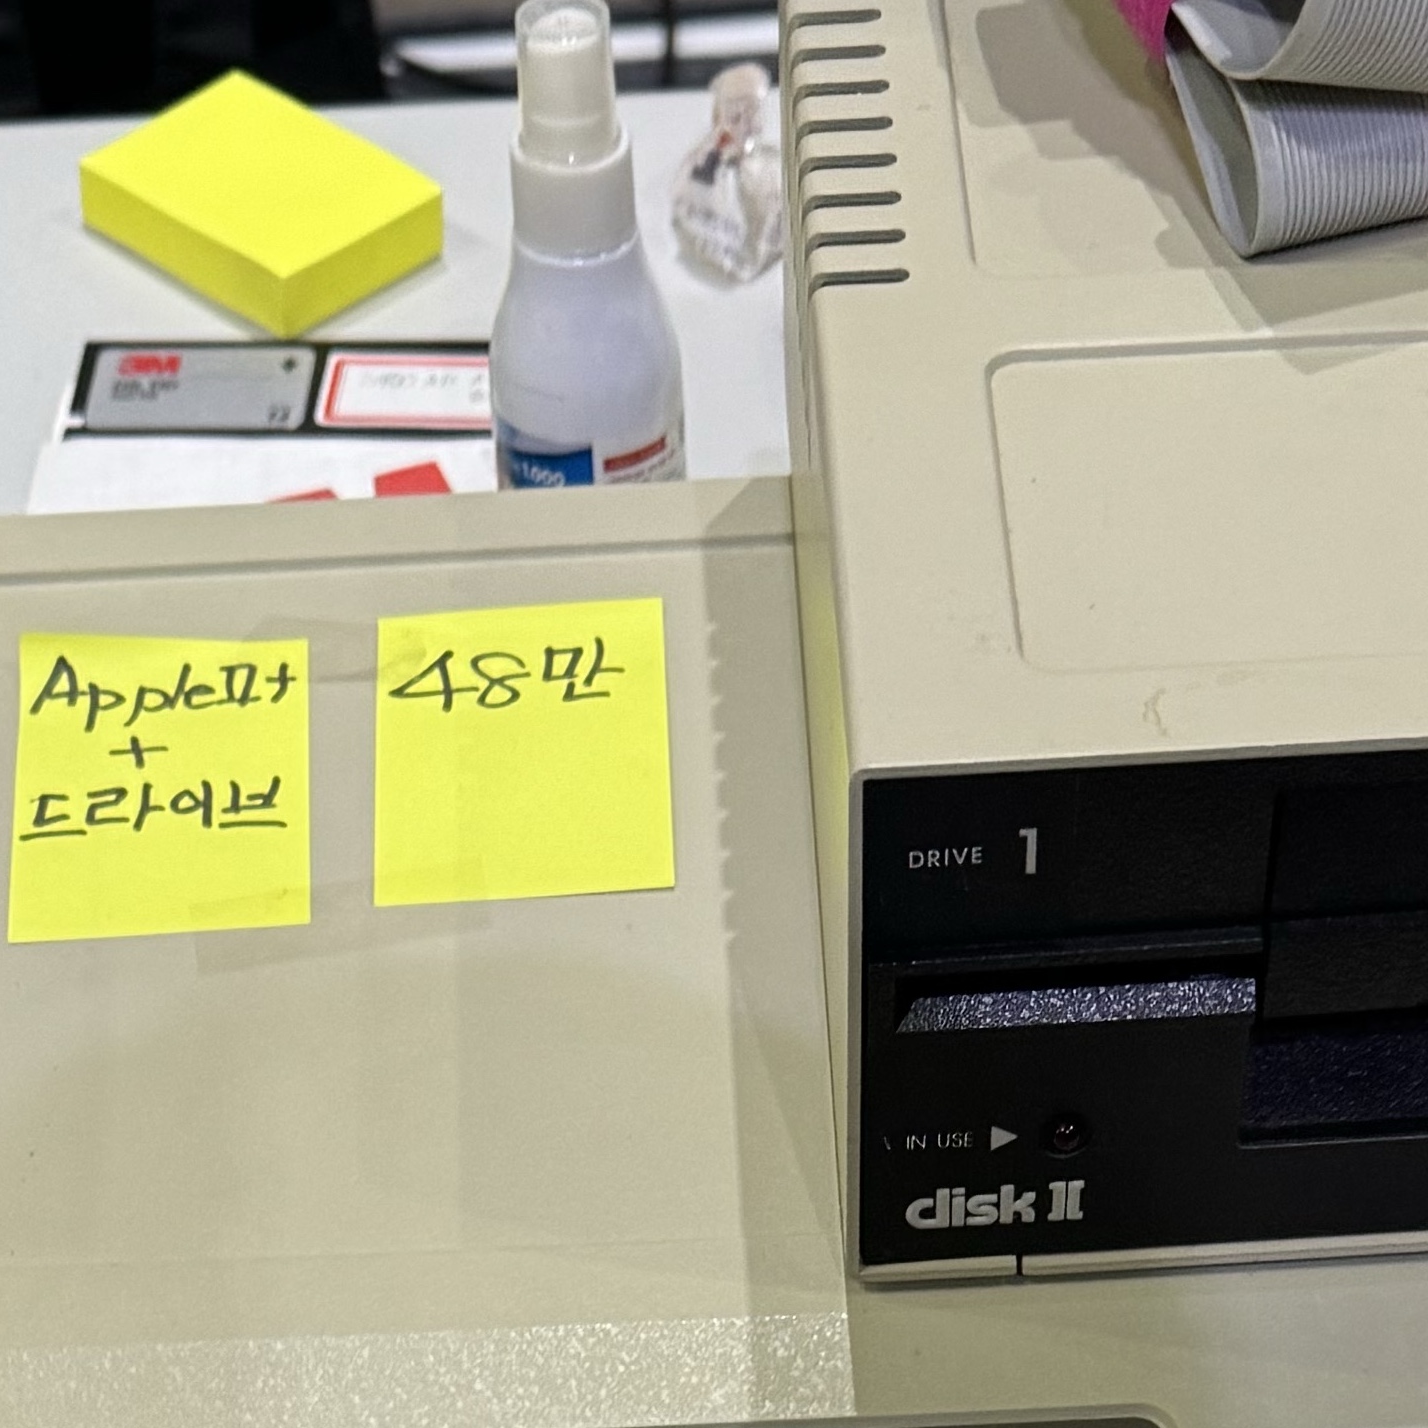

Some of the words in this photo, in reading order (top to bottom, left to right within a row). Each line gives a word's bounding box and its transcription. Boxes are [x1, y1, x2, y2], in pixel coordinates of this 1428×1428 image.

[388, 635, 627, 712] 48만
[18, 776, 288, 841] 드라이브
[907, 843, 985, 870] DRIVE
[1017, 827, 1039, 876] 1
[905, 1134, 927, 1151] IN
[936, 1131, 974, 1149] USE
[904, 1183, 1037, 1231] disk
